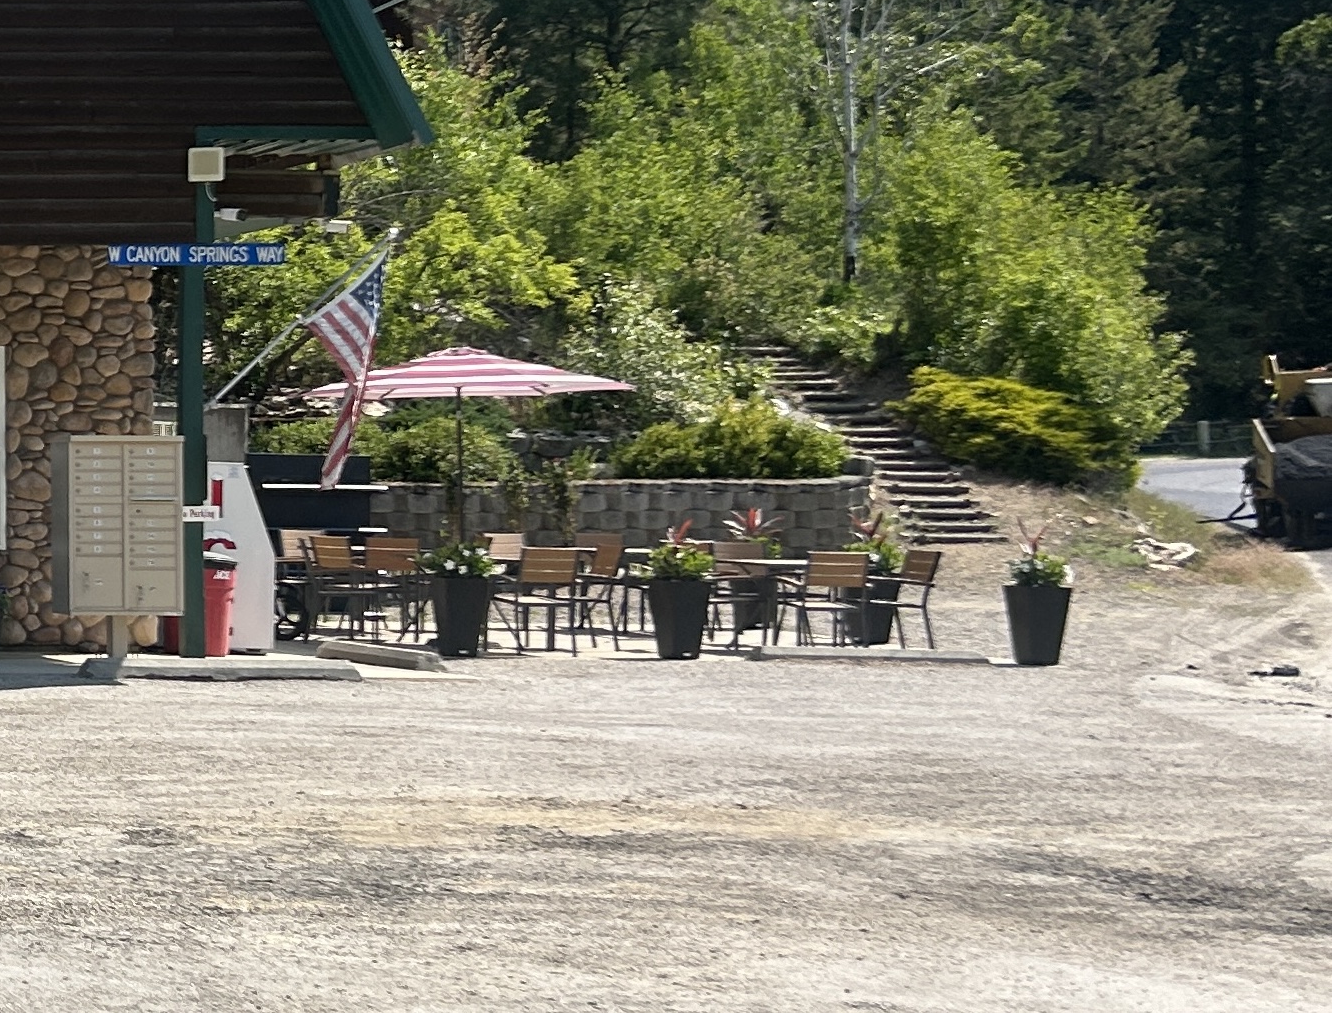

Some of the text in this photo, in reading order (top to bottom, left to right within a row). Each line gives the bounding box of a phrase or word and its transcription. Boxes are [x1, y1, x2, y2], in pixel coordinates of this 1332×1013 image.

[108, 245, 285, 263] W CANYON SPRINGS WAY
